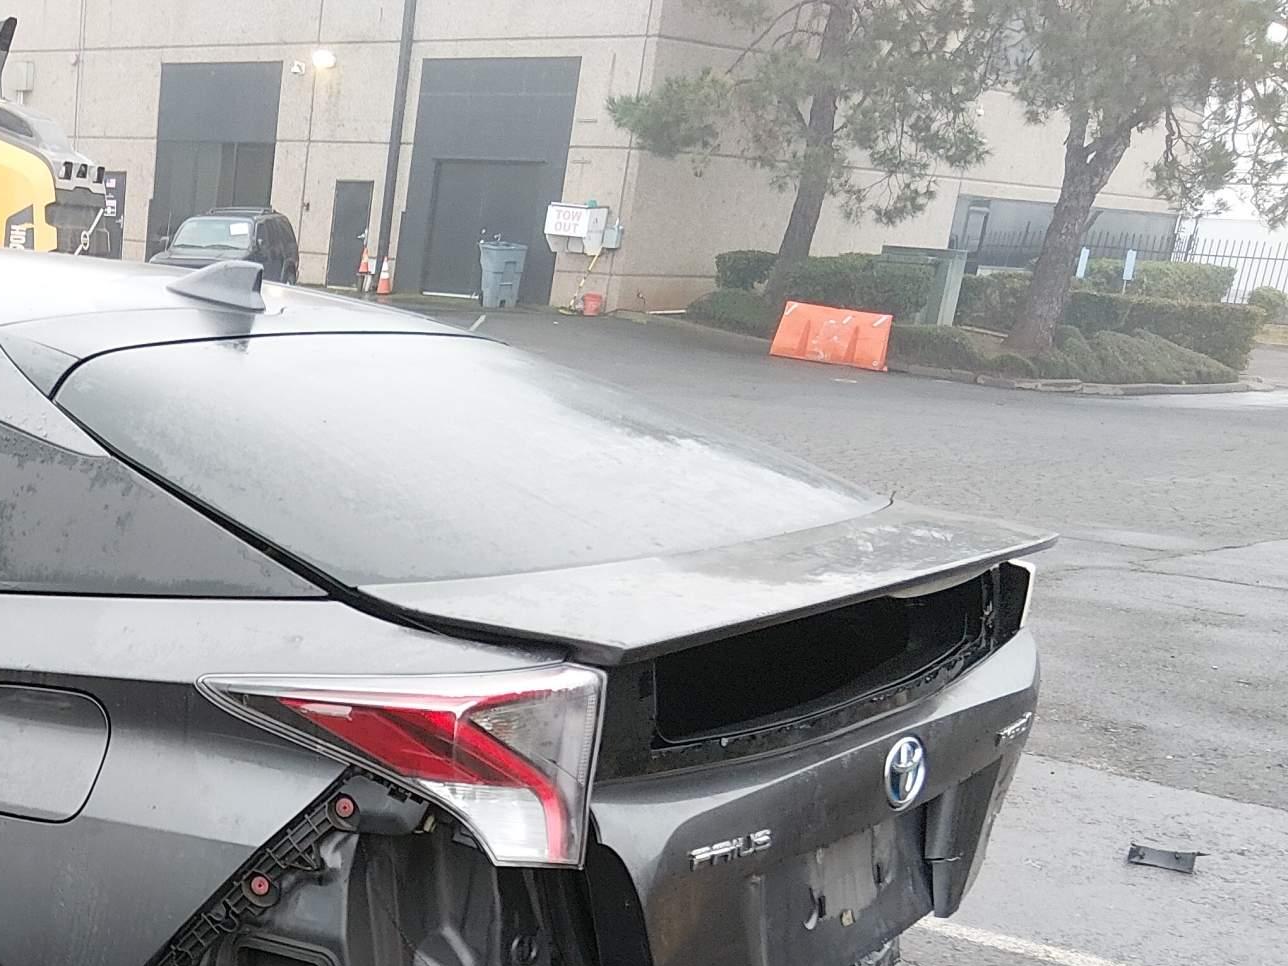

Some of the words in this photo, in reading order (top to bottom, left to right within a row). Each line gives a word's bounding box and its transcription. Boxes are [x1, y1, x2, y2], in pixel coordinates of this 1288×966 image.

[555, 209, 582, 221] TOW
[554, 222, 579, 233] OUT
[688, 829, 771, 871] PRIUS
